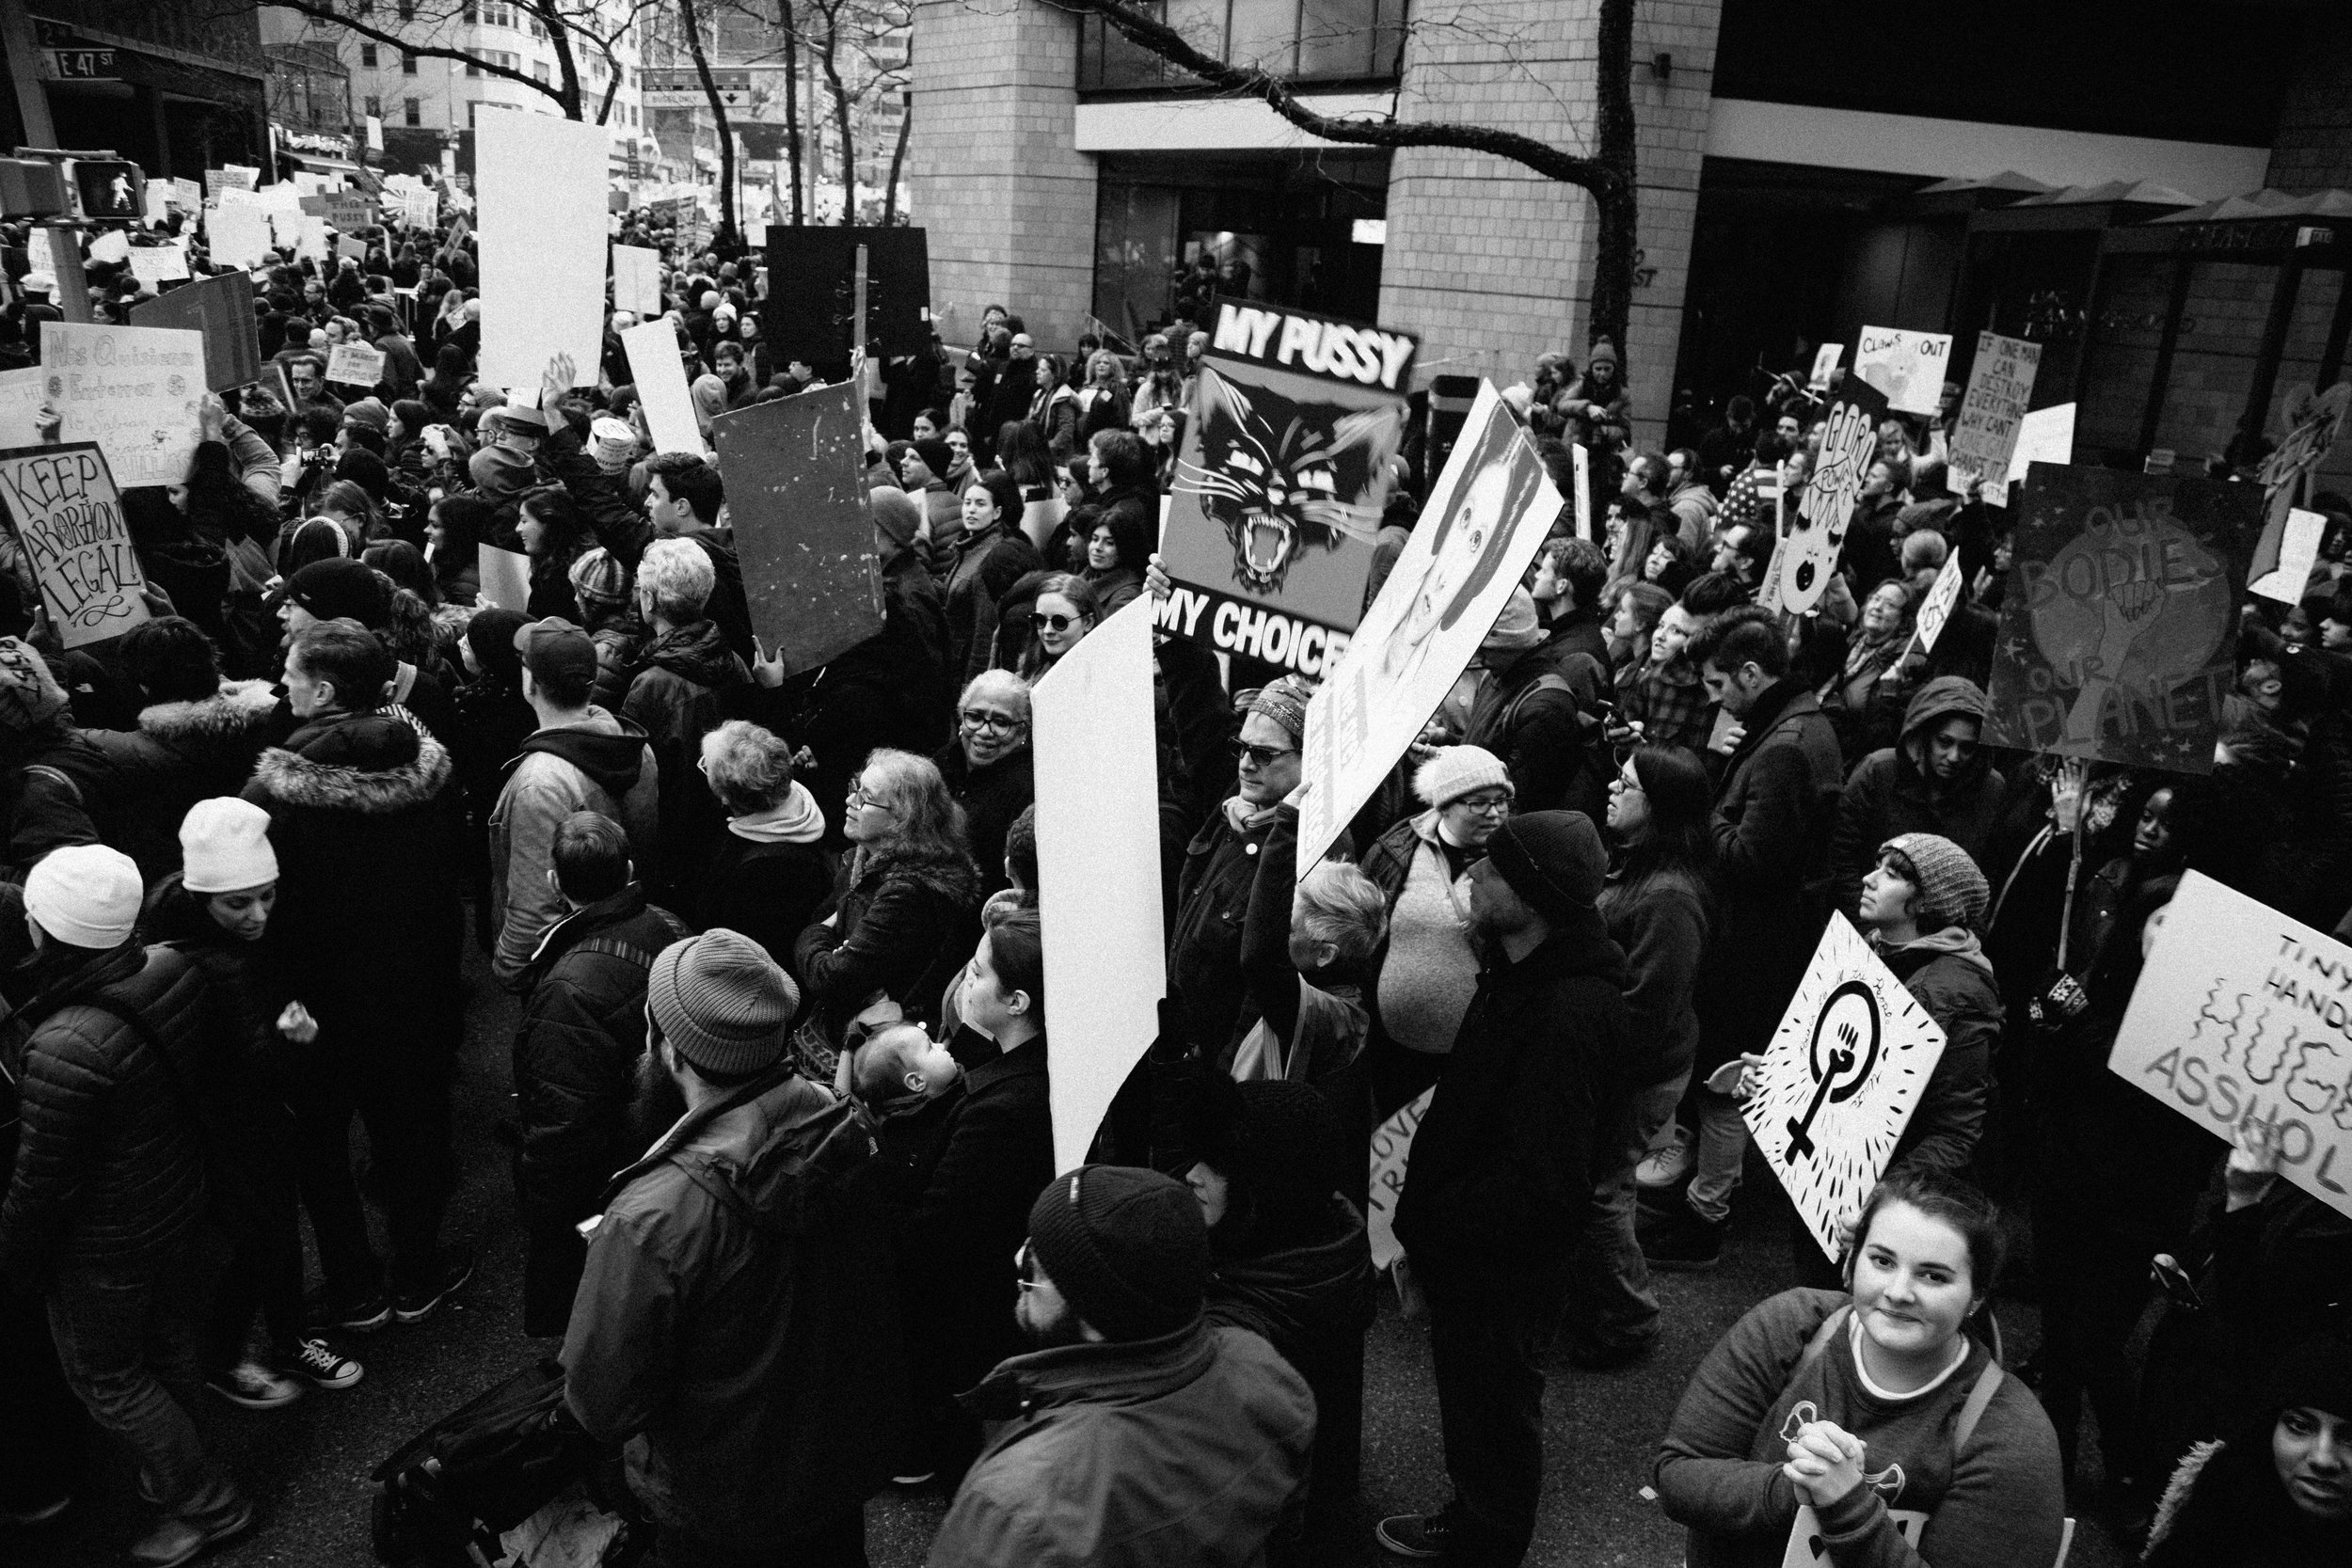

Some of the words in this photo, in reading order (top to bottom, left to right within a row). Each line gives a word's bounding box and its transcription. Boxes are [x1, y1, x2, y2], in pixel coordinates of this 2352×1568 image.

[59, 53, 72, 75] E
[77, 54, 95, 75] 47
[100, 53, 113, 65] ST
[50, 331, 87, 369] Nos
[1214, 304, 1281, 357] MY
[1278, 315, 1415, 389] PUSSY
[1919, 339, 1947, 357] OUT
[1992, 358, 2016, 379] CAN
[1998, 340, 2019, 359] ONE
[1979, 372, 2030, 401] DESTROY
[1825, 410, 1873, 483] GIRL
[0, 454, 98, 519] KEEP
[1820, 465, 1851, 505] POWER
[23, 499, 126, 571] ABORTION
[2085, 497, 2192, 537] OUR
[40, 544, 141, 621] LEGAL!
[2017, 531, 2225, 611] BODIES
[1152, 588, 1210, 637] MY
[2026, 656, 2113, 690] OUR
[2021, 661, 2234, 751] PLANET
[2145, 1046, 2350, 1196] ASSHOL
